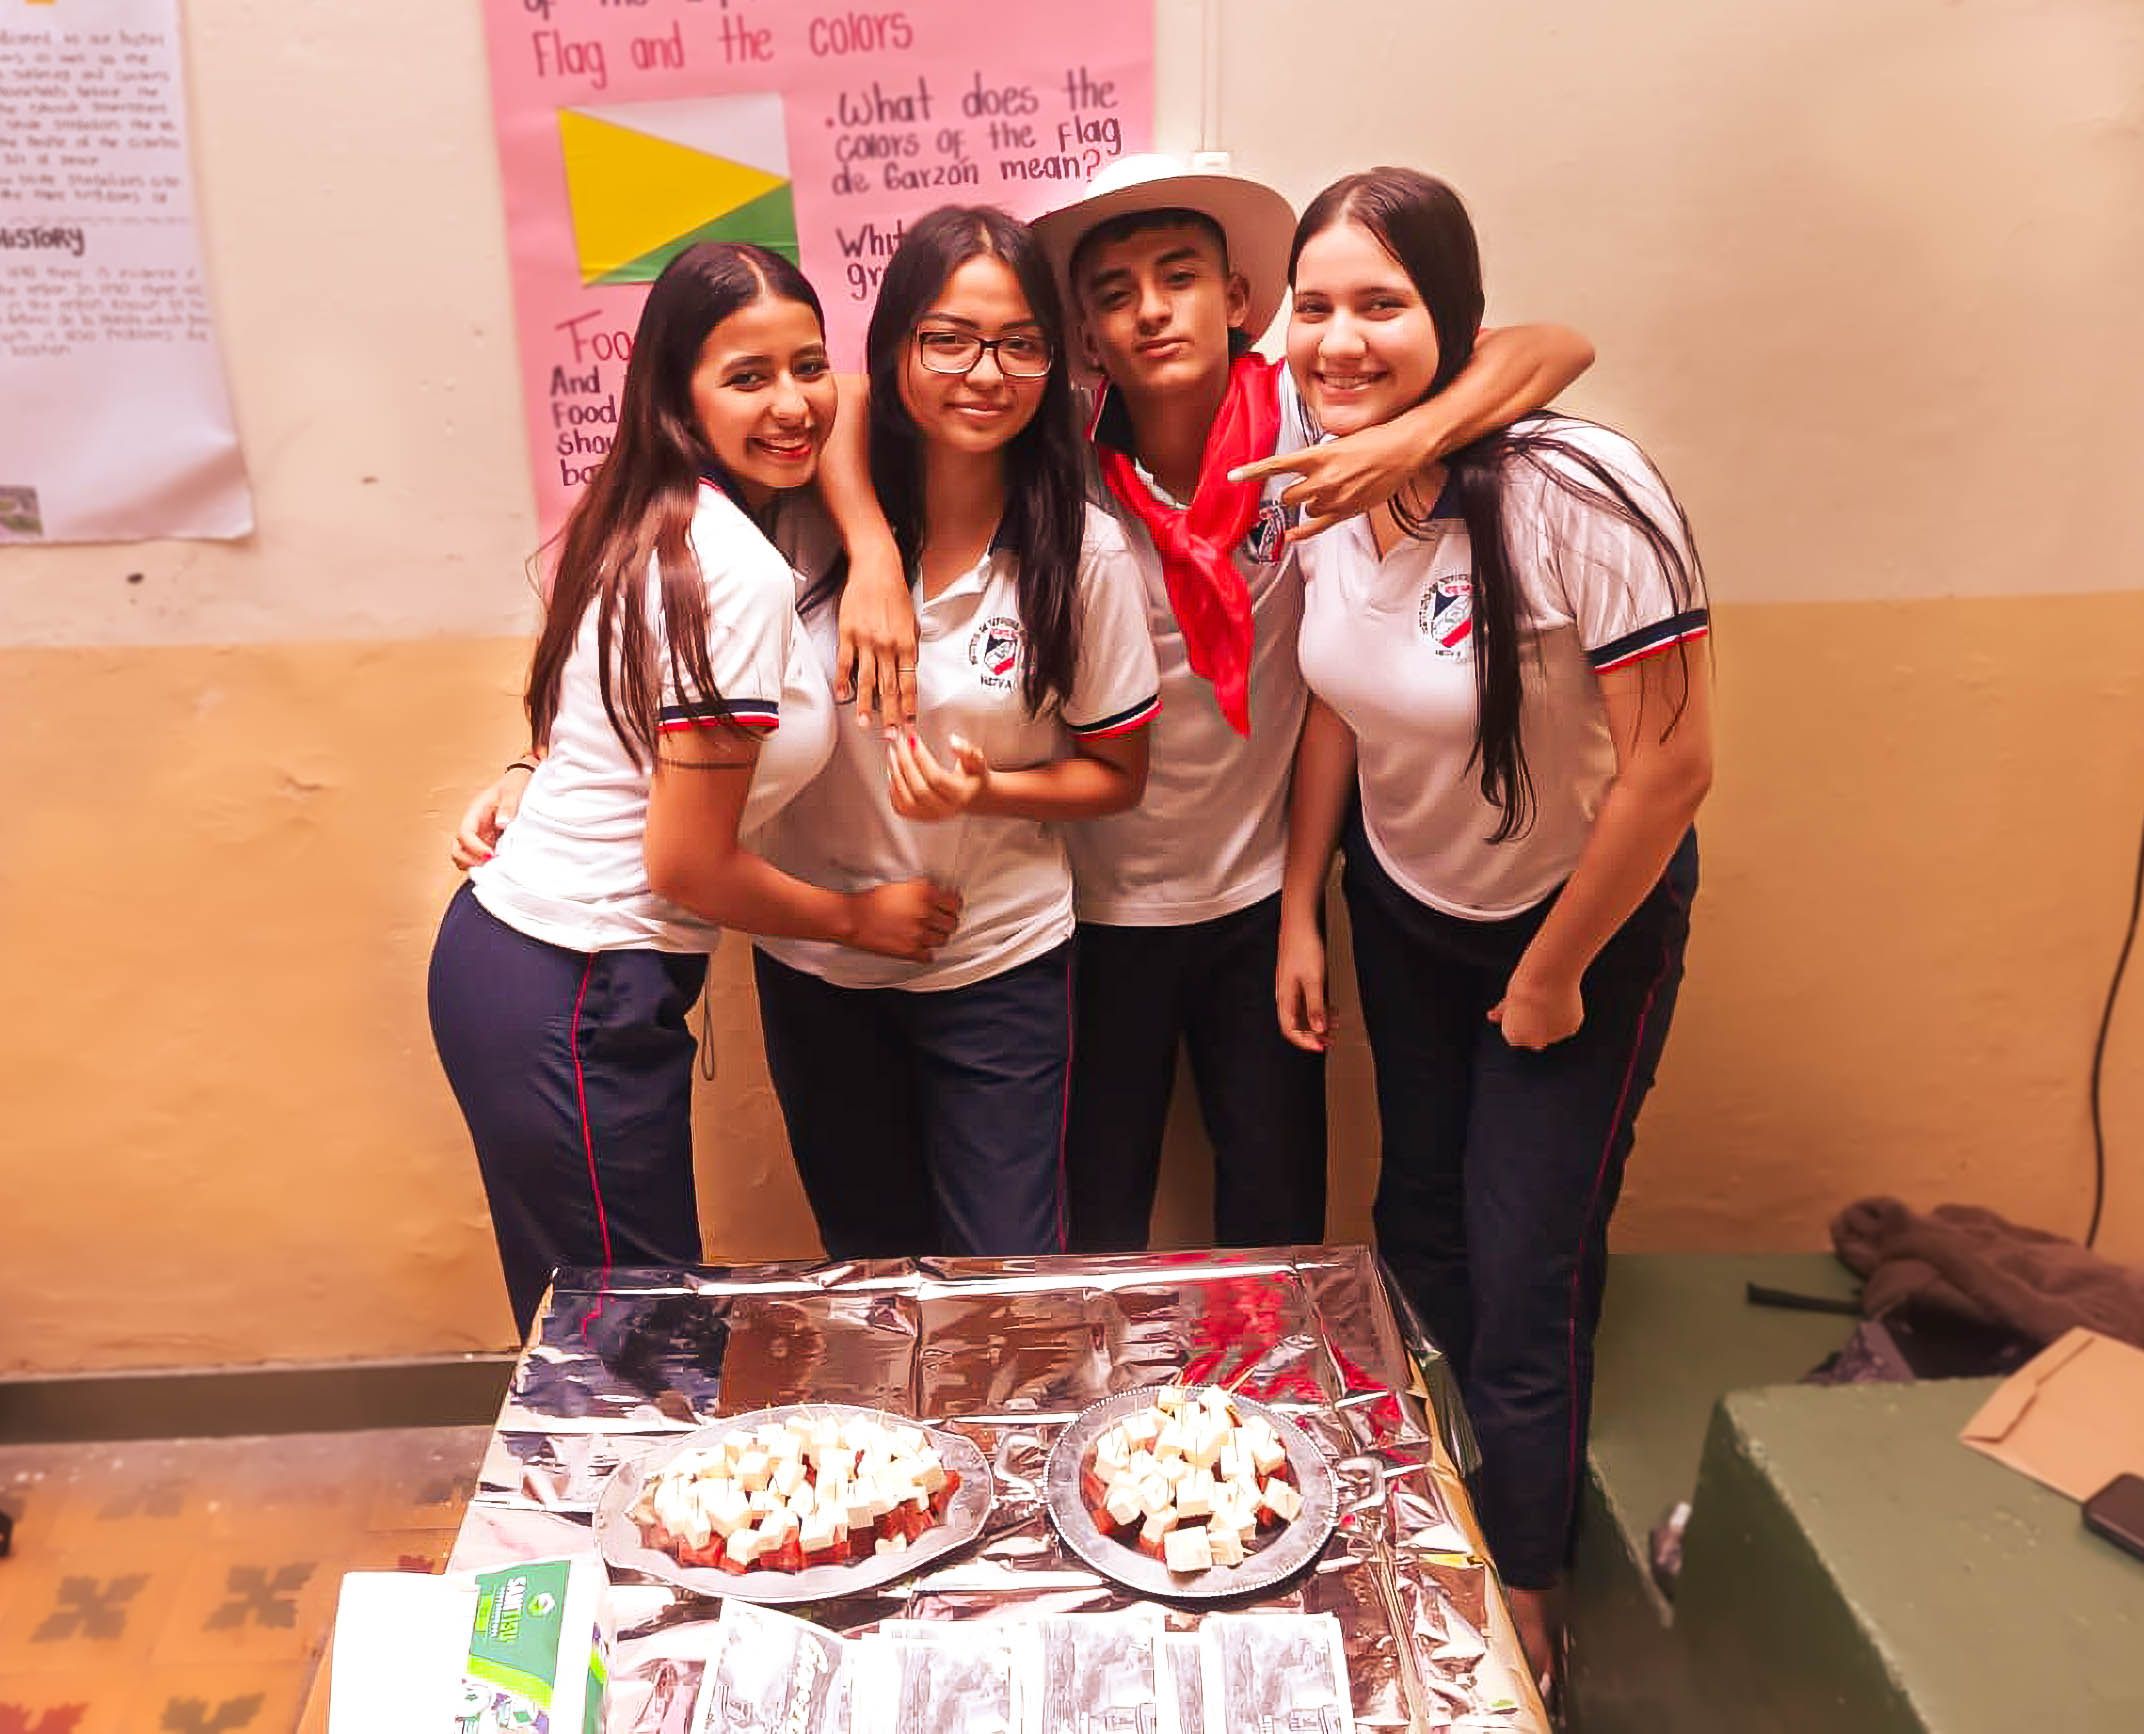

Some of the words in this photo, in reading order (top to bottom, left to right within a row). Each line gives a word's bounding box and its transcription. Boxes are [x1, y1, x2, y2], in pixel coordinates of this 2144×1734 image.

[531, 29, 607, 90] Flag
[630, 19, 685, 70] and
[718, 14, 774, 63] the
[961, 70, 1038, 117] does
[1062, 65, 1119, 111] the
[936, 128, 967, 162] of
[990, 122, 1036, 150] the
[832, 163, 870, 196] de
[1000, 149, 1101, 182] mean?
[835, 219, 908, 257] Whit
[847, 262, 882, 301] gr
[555, 310, 633, 364] Foo
[551, 364, 600, 395] And
[552, 394, 617, 429] Food
